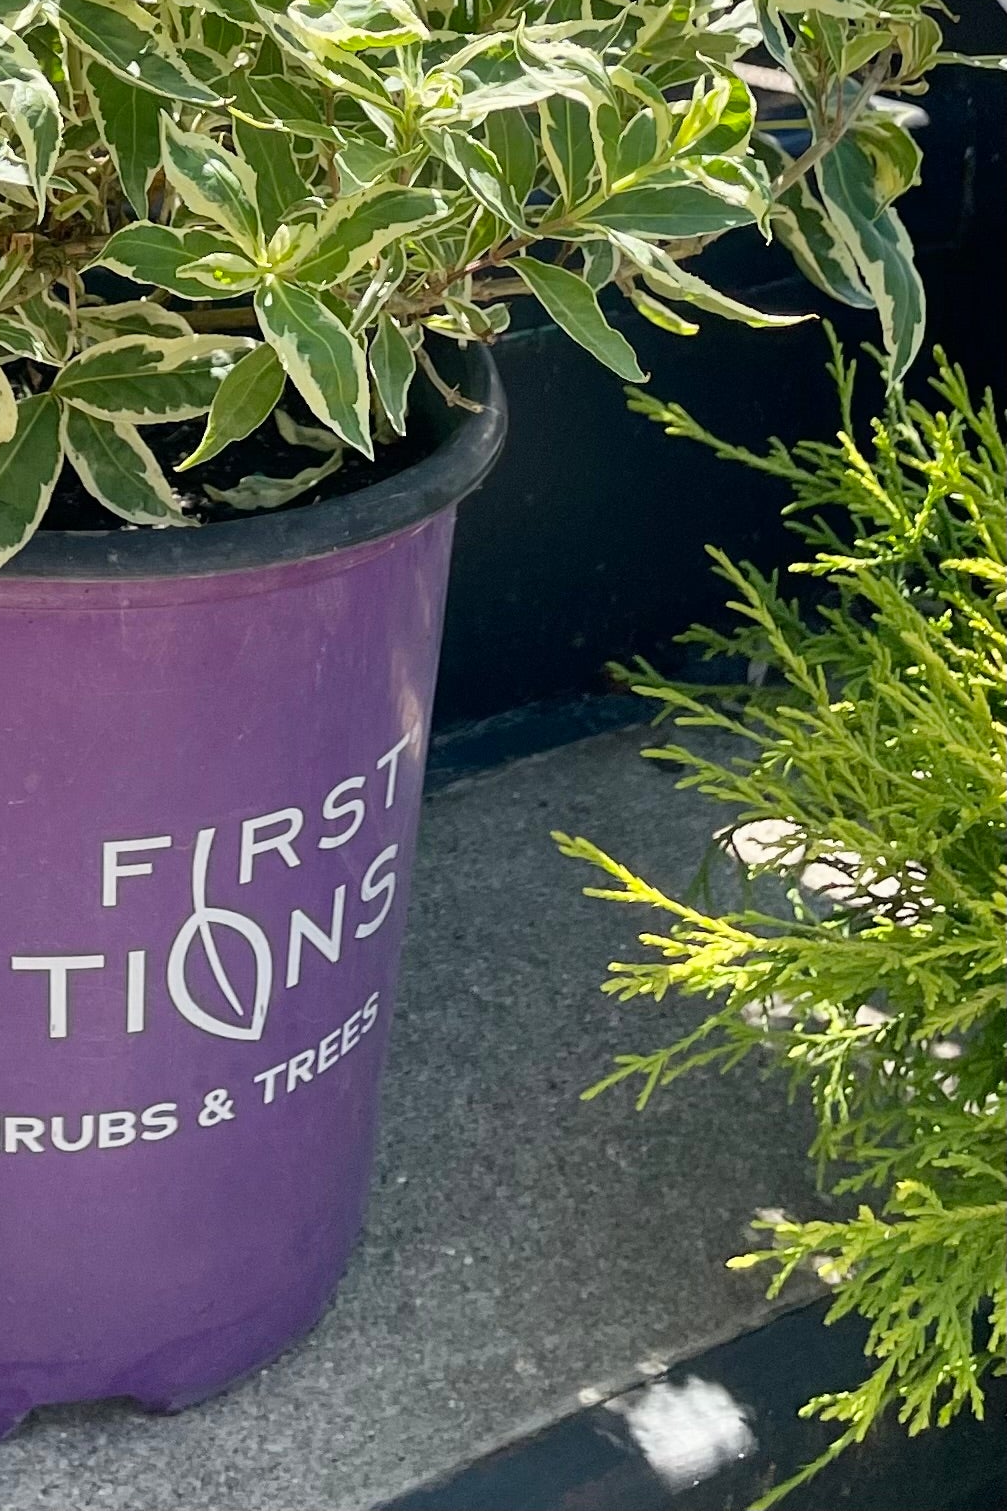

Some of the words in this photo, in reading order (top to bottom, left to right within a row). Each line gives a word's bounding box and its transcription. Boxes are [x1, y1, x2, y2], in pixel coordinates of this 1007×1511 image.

[101, 732, 411, 908] FIRST
[197, 1088, 236, 1128] &
[253, 991, 380, 1105] TREES
